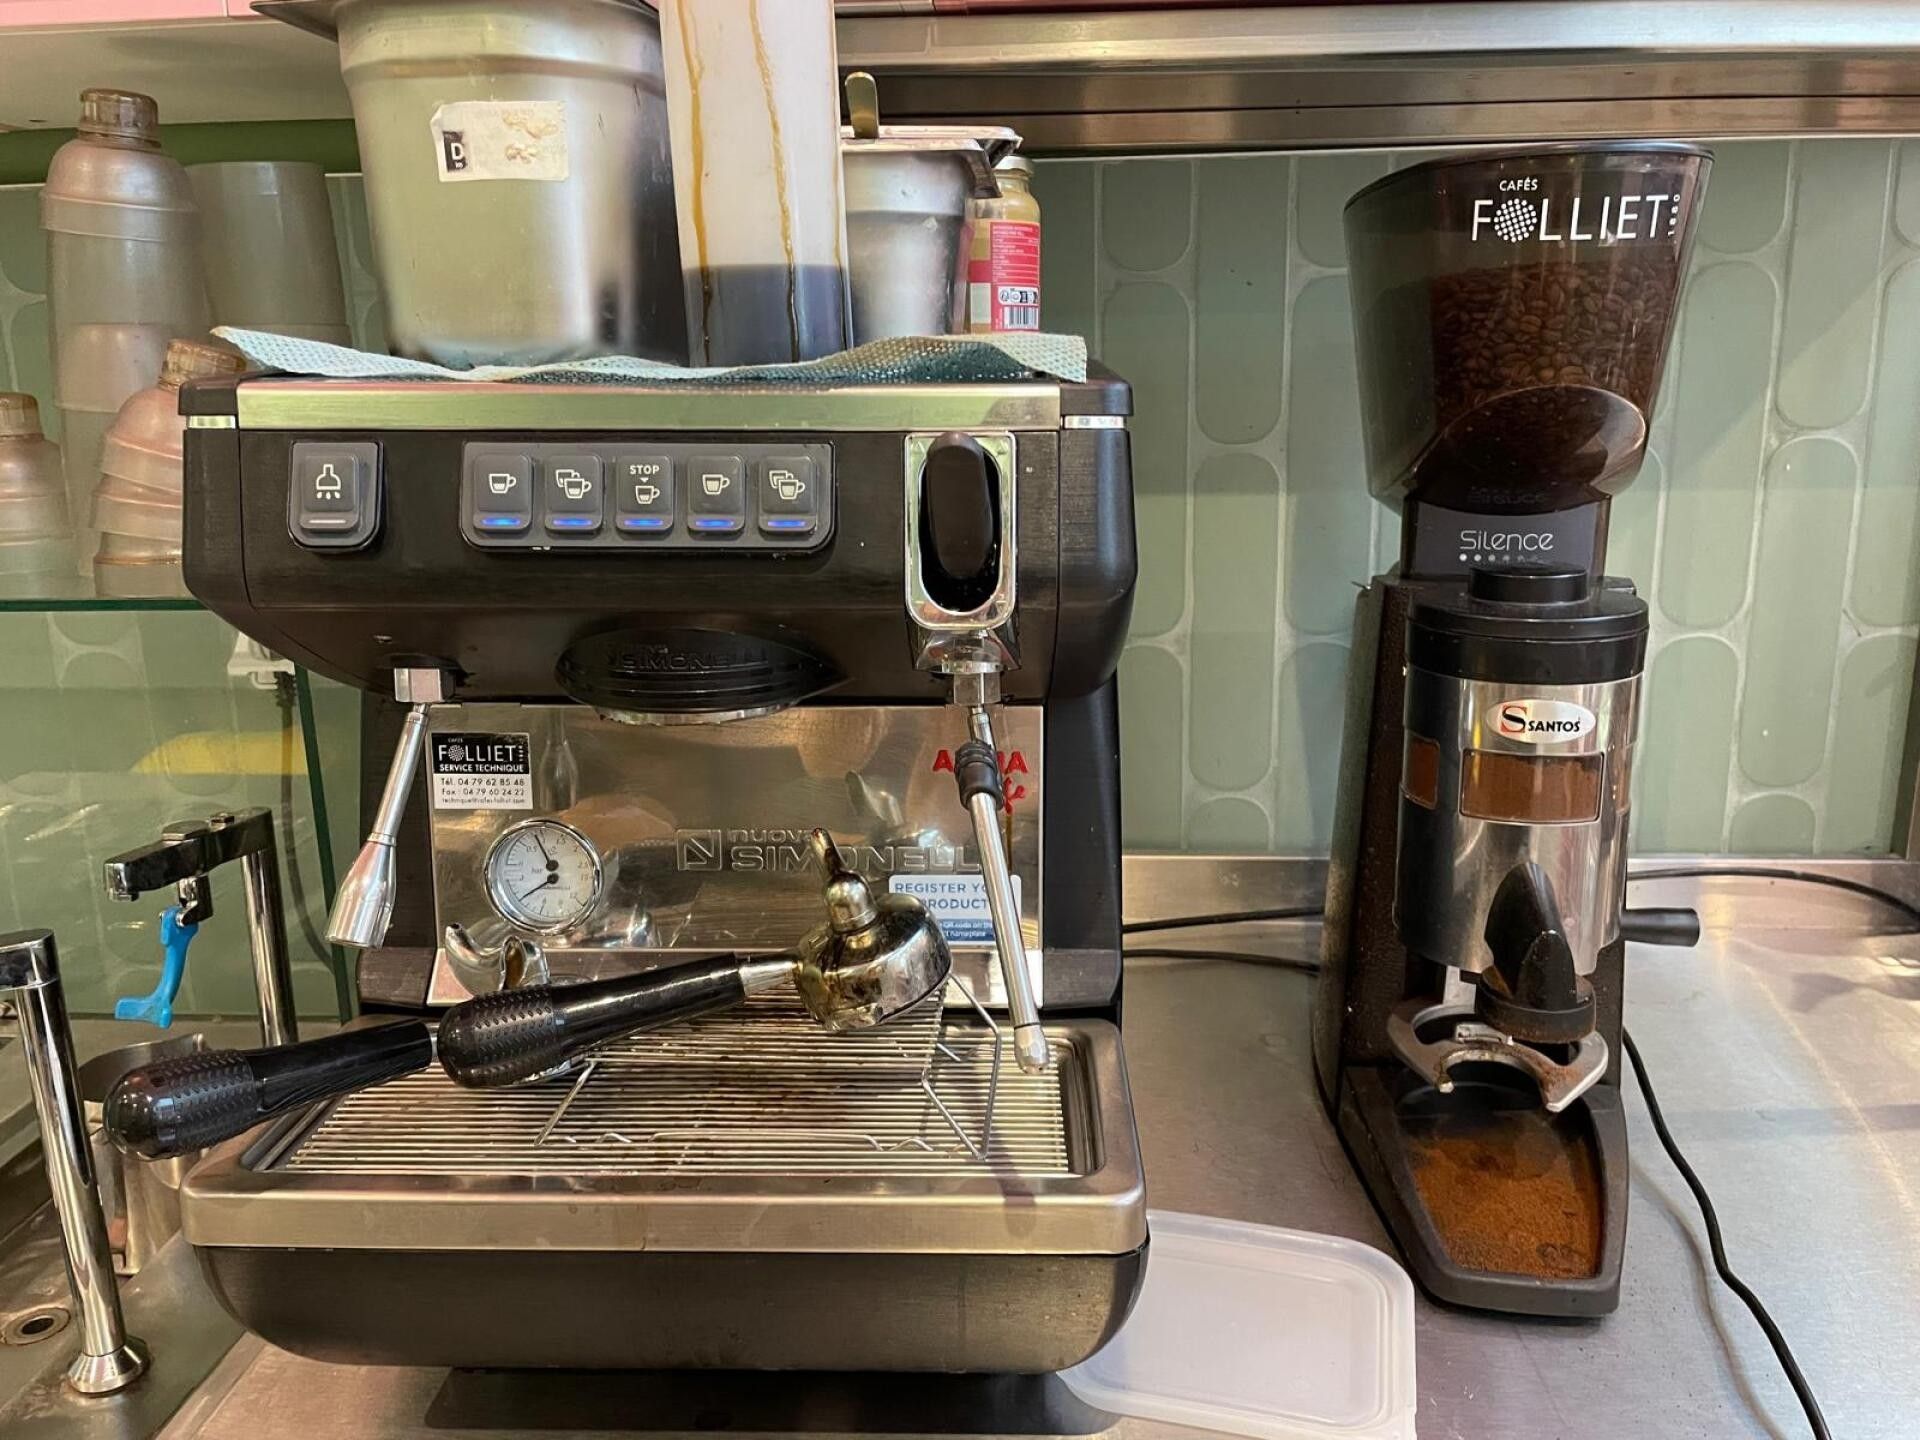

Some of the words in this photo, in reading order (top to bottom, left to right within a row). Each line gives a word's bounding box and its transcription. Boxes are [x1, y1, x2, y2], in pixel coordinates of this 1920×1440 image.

[1500, 177, 1538, 191] CAFÉS
[630, 464, 660, 475] STOP
[1460, 530, 1554, 551] Silence
[1528, 720, 1580, 732] SANTOS
[440, 763, 473, 772] SERVICE
[475, 763, 525, 773] TECHNIQUE
[457, 778, 469, 786] 04
[472, 778, 483, 786] 79
[486, 778, 496, 787] 62
[730, 845, 982, 871] SIMONELL
[895, 883, 966, 893] REGISTER
